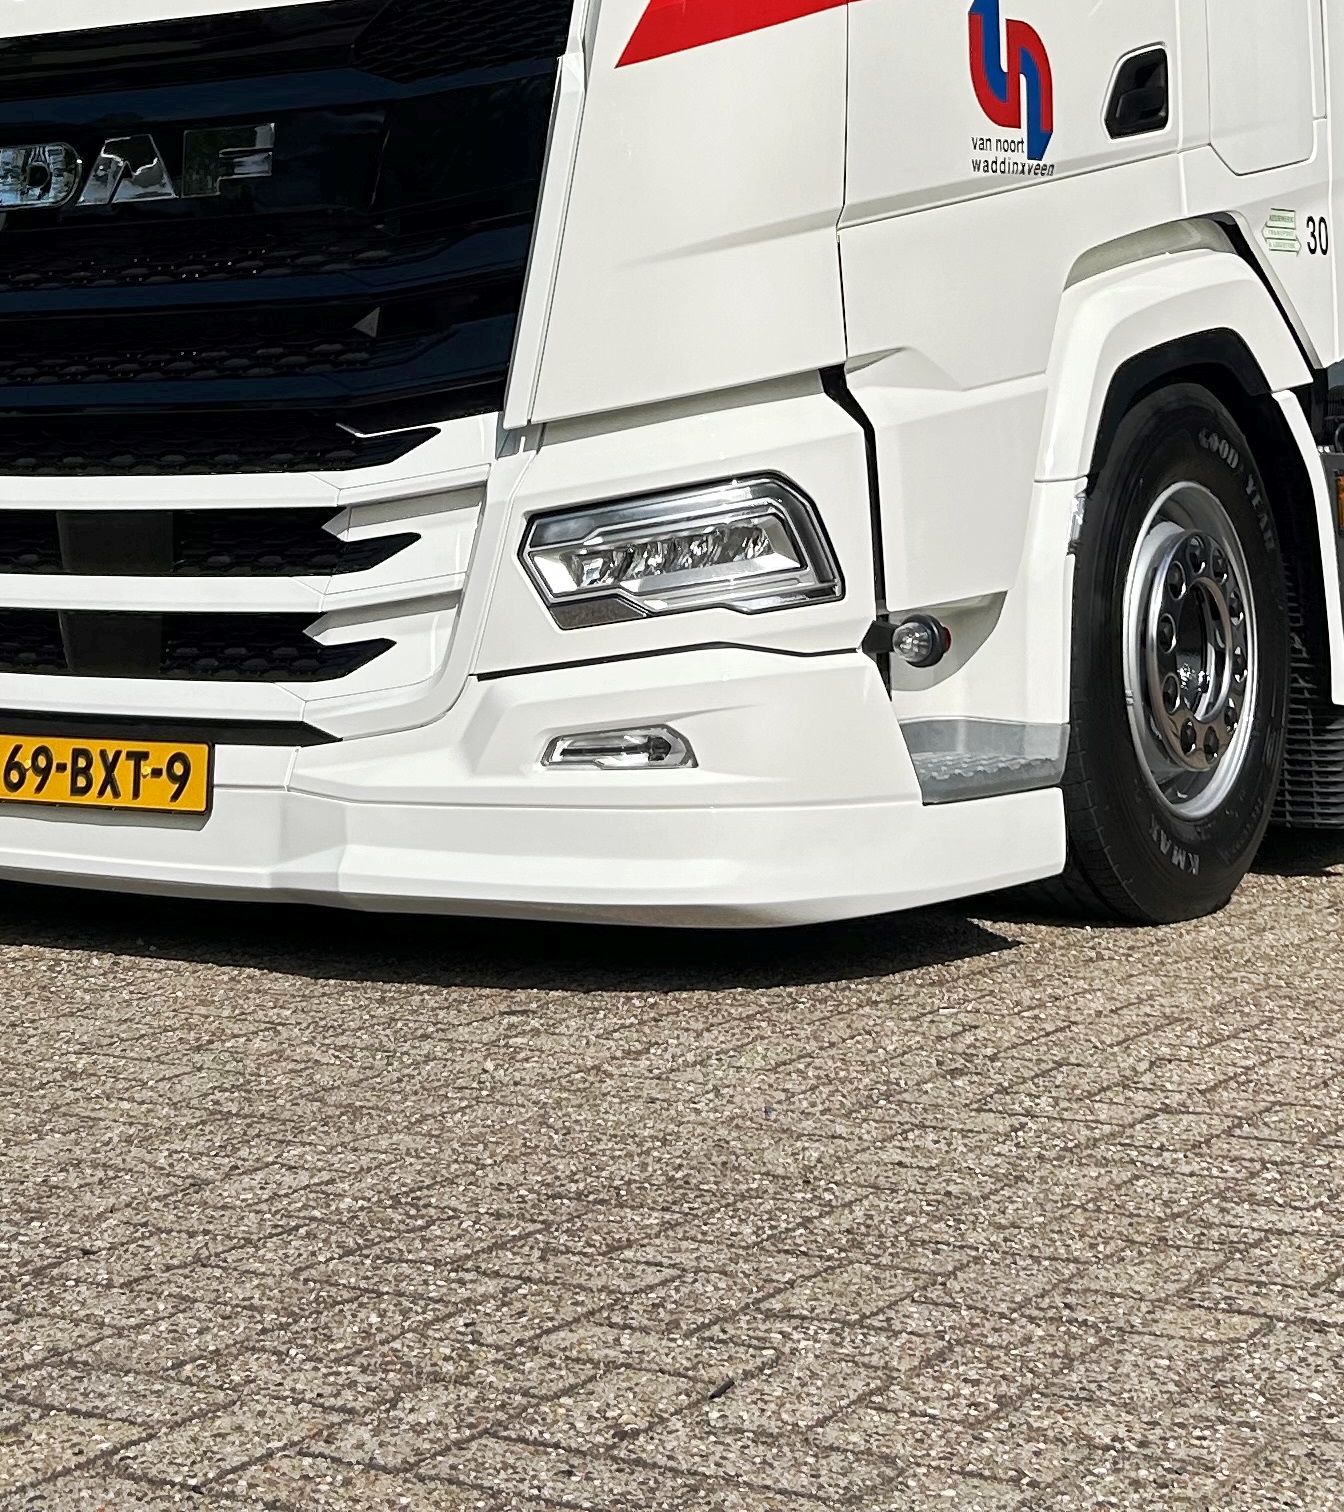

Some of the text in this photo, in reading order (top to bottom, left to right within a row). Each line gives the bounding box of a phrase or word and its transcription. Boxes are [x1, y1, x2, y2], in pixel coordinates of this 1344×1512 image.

[971, 136, 1025, 153] van noort
[971, 156, 1055, 176] waddinxveen
[1306, 215, 1329, 255] 30
[2, 743, 192, 804] 69-BXT-9
